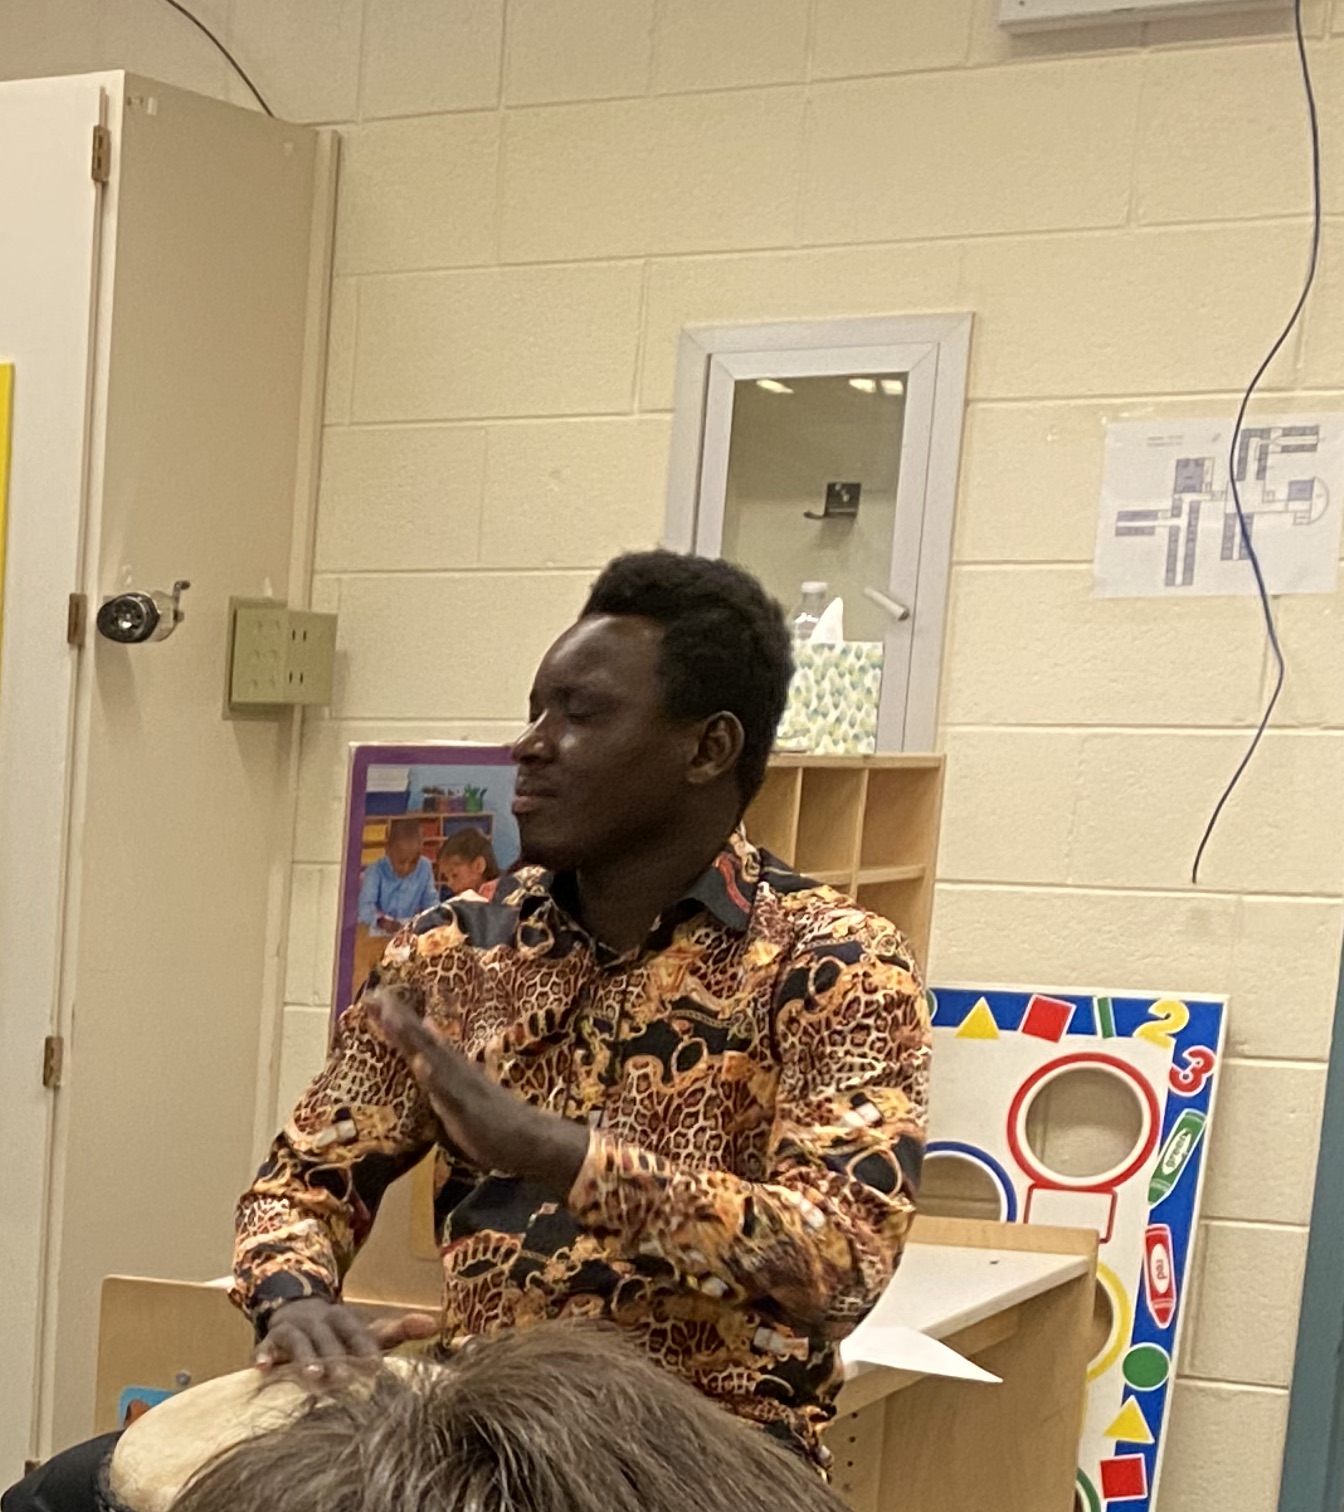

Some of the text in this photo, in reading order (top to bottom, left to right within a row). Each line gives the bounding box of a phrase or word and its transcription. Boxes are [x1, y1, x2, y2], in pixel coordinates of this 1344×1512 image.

[1133, 999, 1189, 1051] 2
[1168, 1046, 1215, 1095] 3
[1155, 1259, 1167, 1280] red
